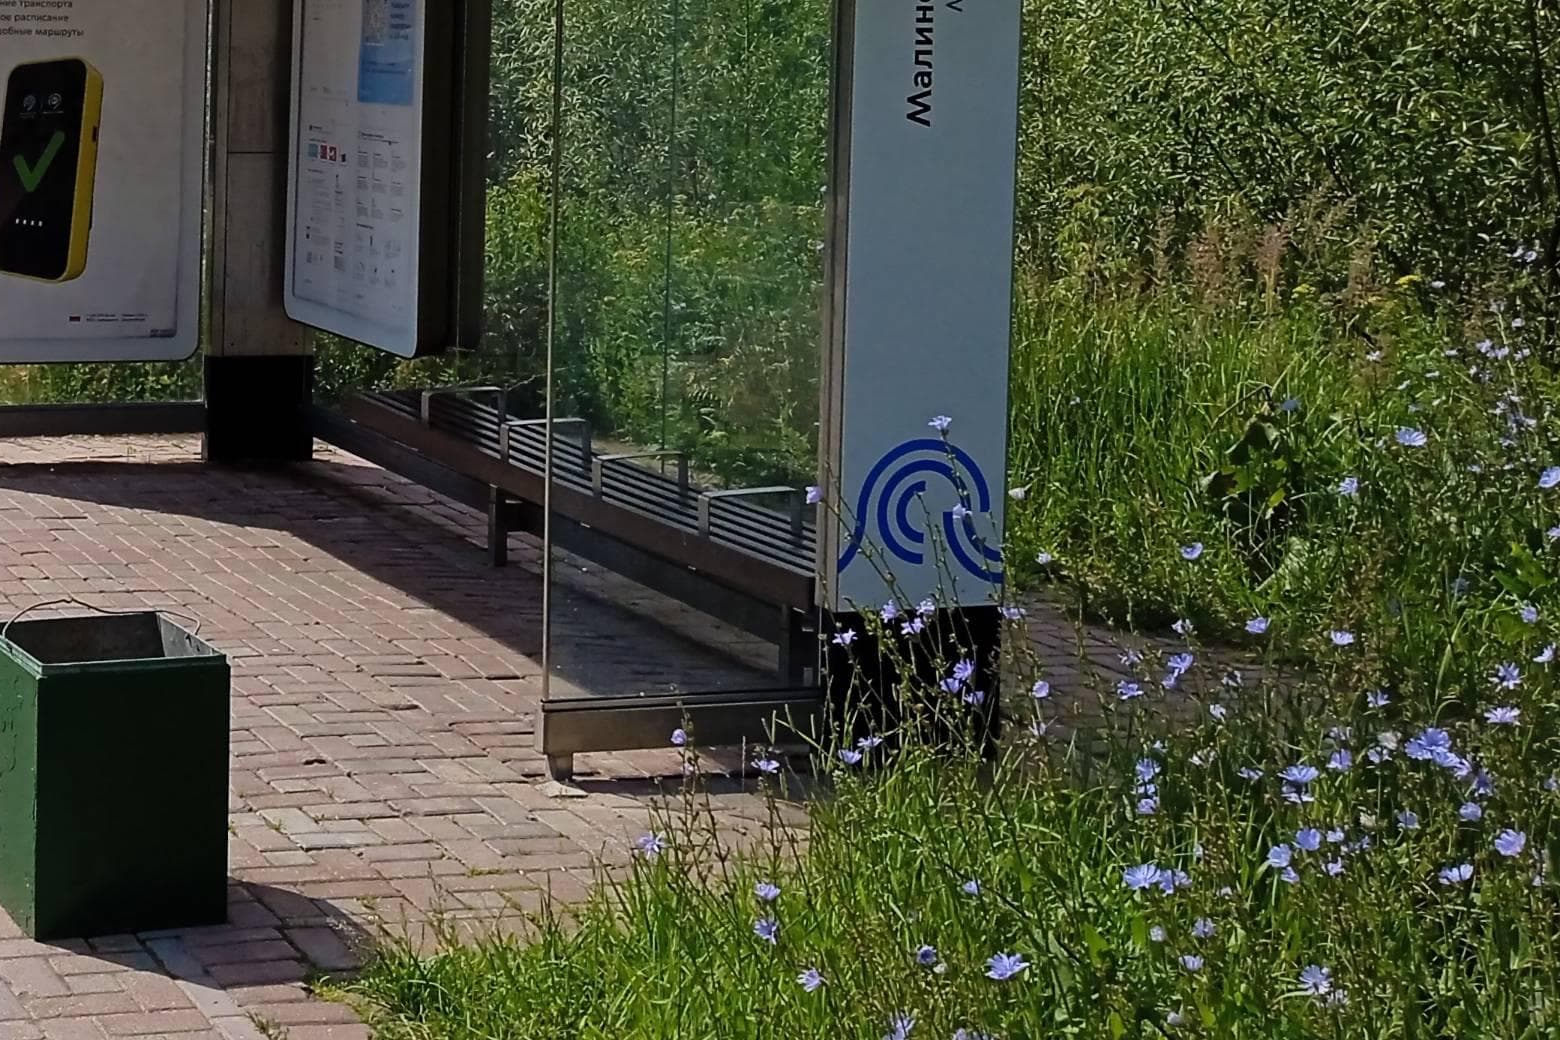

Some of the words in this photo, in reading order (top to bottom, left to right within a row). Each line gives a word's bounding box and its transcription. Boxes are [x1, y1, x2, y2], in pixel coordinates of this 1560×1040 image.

[19, 0, 73, 9] транспорта
[14, 14, 70, 23] расписание
[35, 28, 85, 38] маршруты
